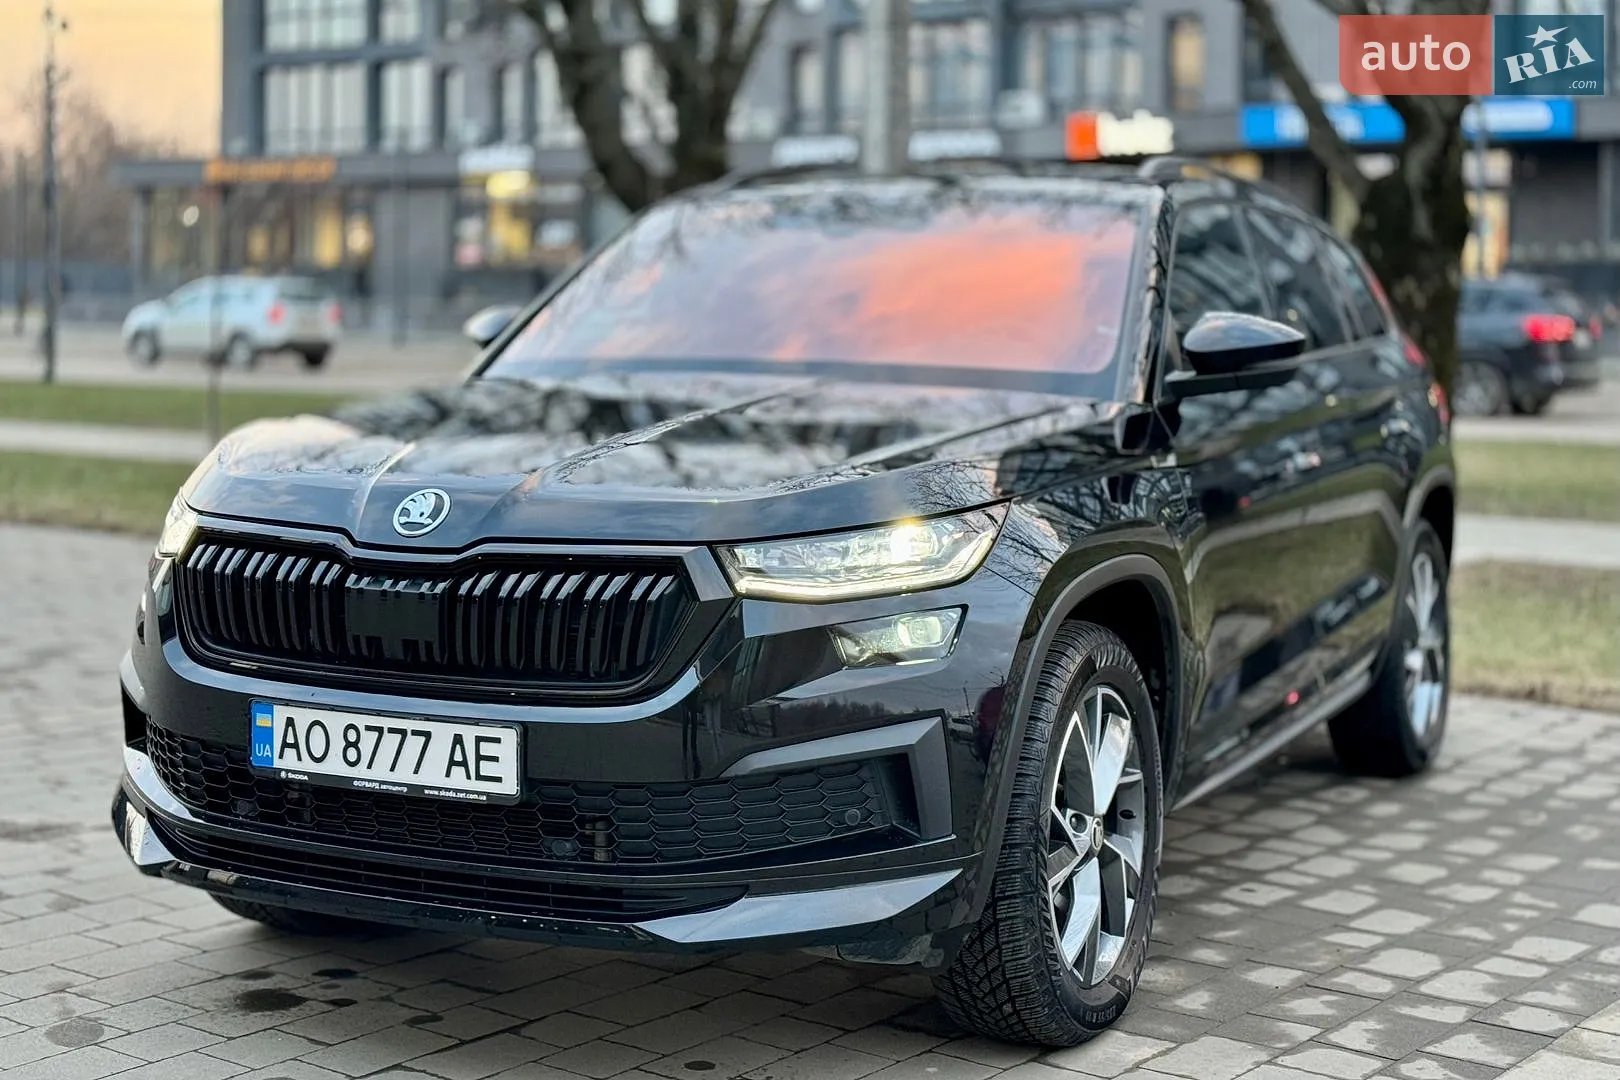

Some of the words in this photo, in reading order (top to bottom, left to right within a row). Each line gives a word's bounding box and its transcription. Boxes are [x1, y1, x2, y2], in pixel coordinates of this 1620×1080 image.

[255, 743, 272, 758] UA
[278, 716, 331, 764] AO
[342, 723, 432, 775] 8777
[445, 733, 503, 784] AE
